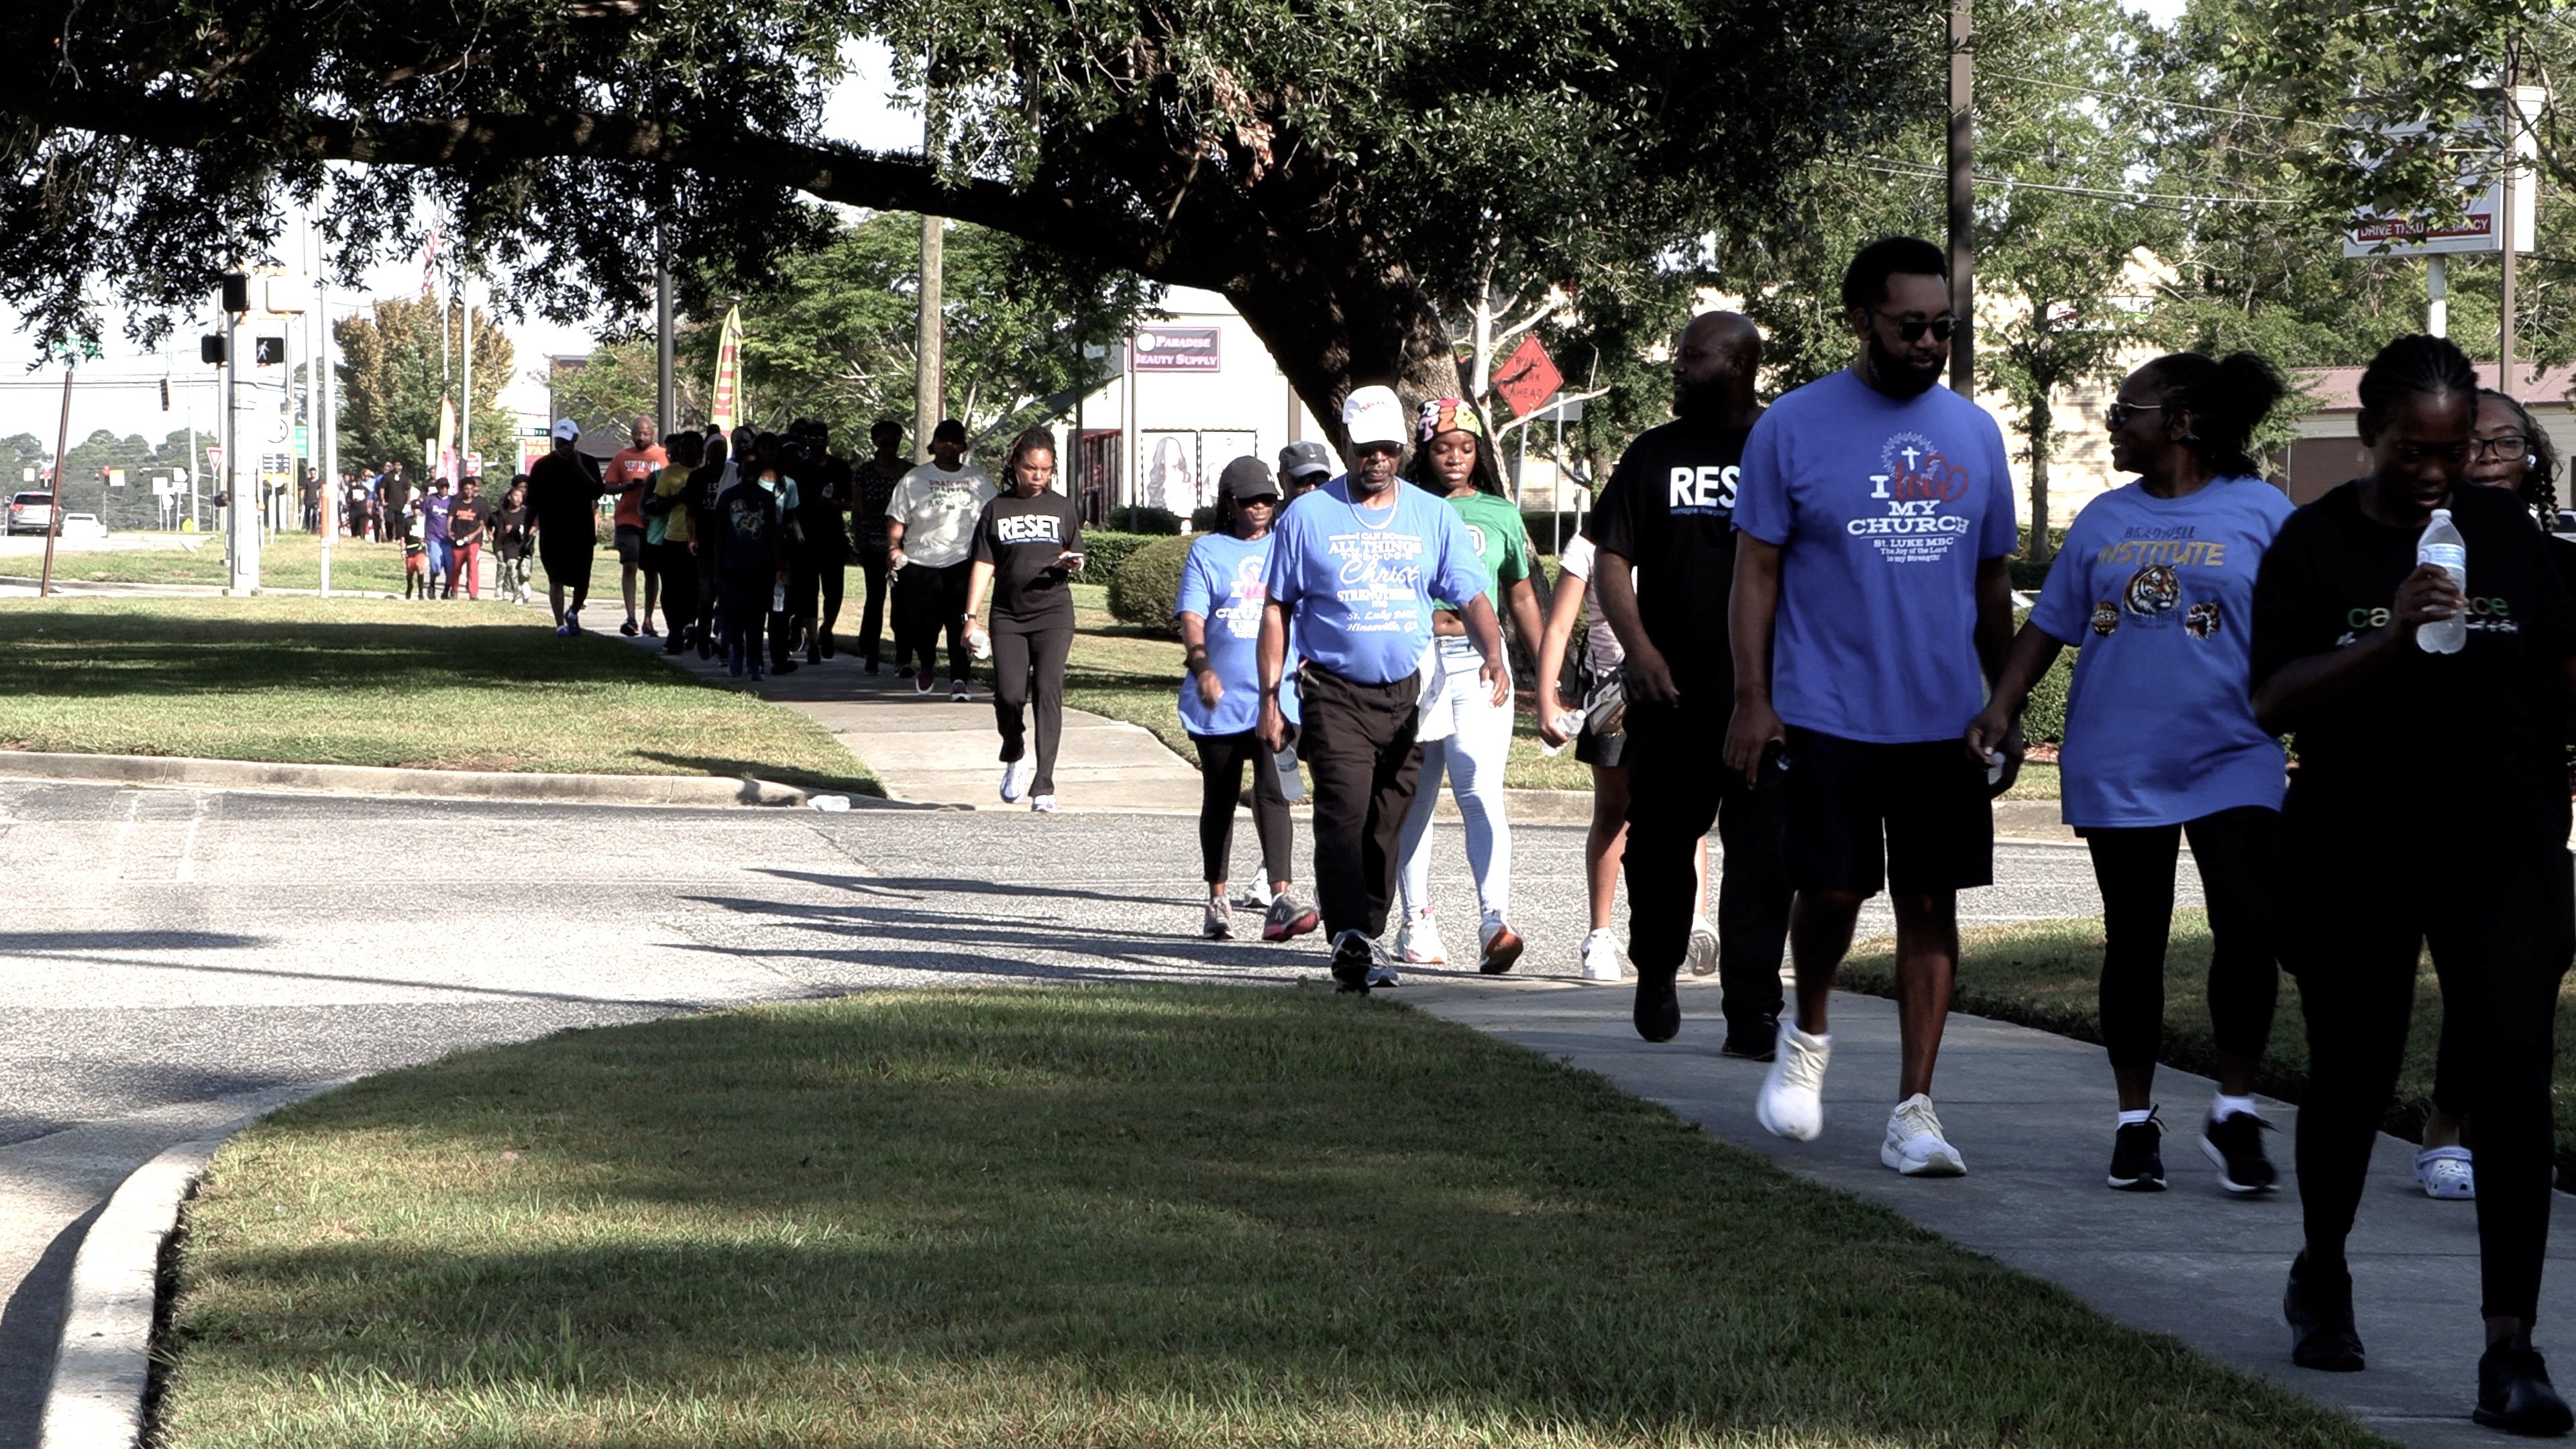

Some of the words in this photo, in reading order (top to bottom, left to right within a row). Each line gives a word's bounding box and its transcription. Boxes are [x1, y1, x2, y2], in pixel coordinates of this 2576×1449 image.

[2394, 222, 2424, 235] THU
[1155, 335, 1211, 347] PARADISE
[1176, 354, 1217, 365] SUPPLY
[1670, 466, 1741, 508] RES
[1869, 474, 1890, 498] I
[1888, 499, 1941, 517] MY
[997, 514, 1061, 541] RESET
[1847, 515, 1970, 535] CHURCH
[1328, 541, 1360, 555] ALL
[1360, 540, 1423, 554] THINGS
[1890, 538, 1924, 548] LUKE
[1339, 558, 1420, 585] Christ
